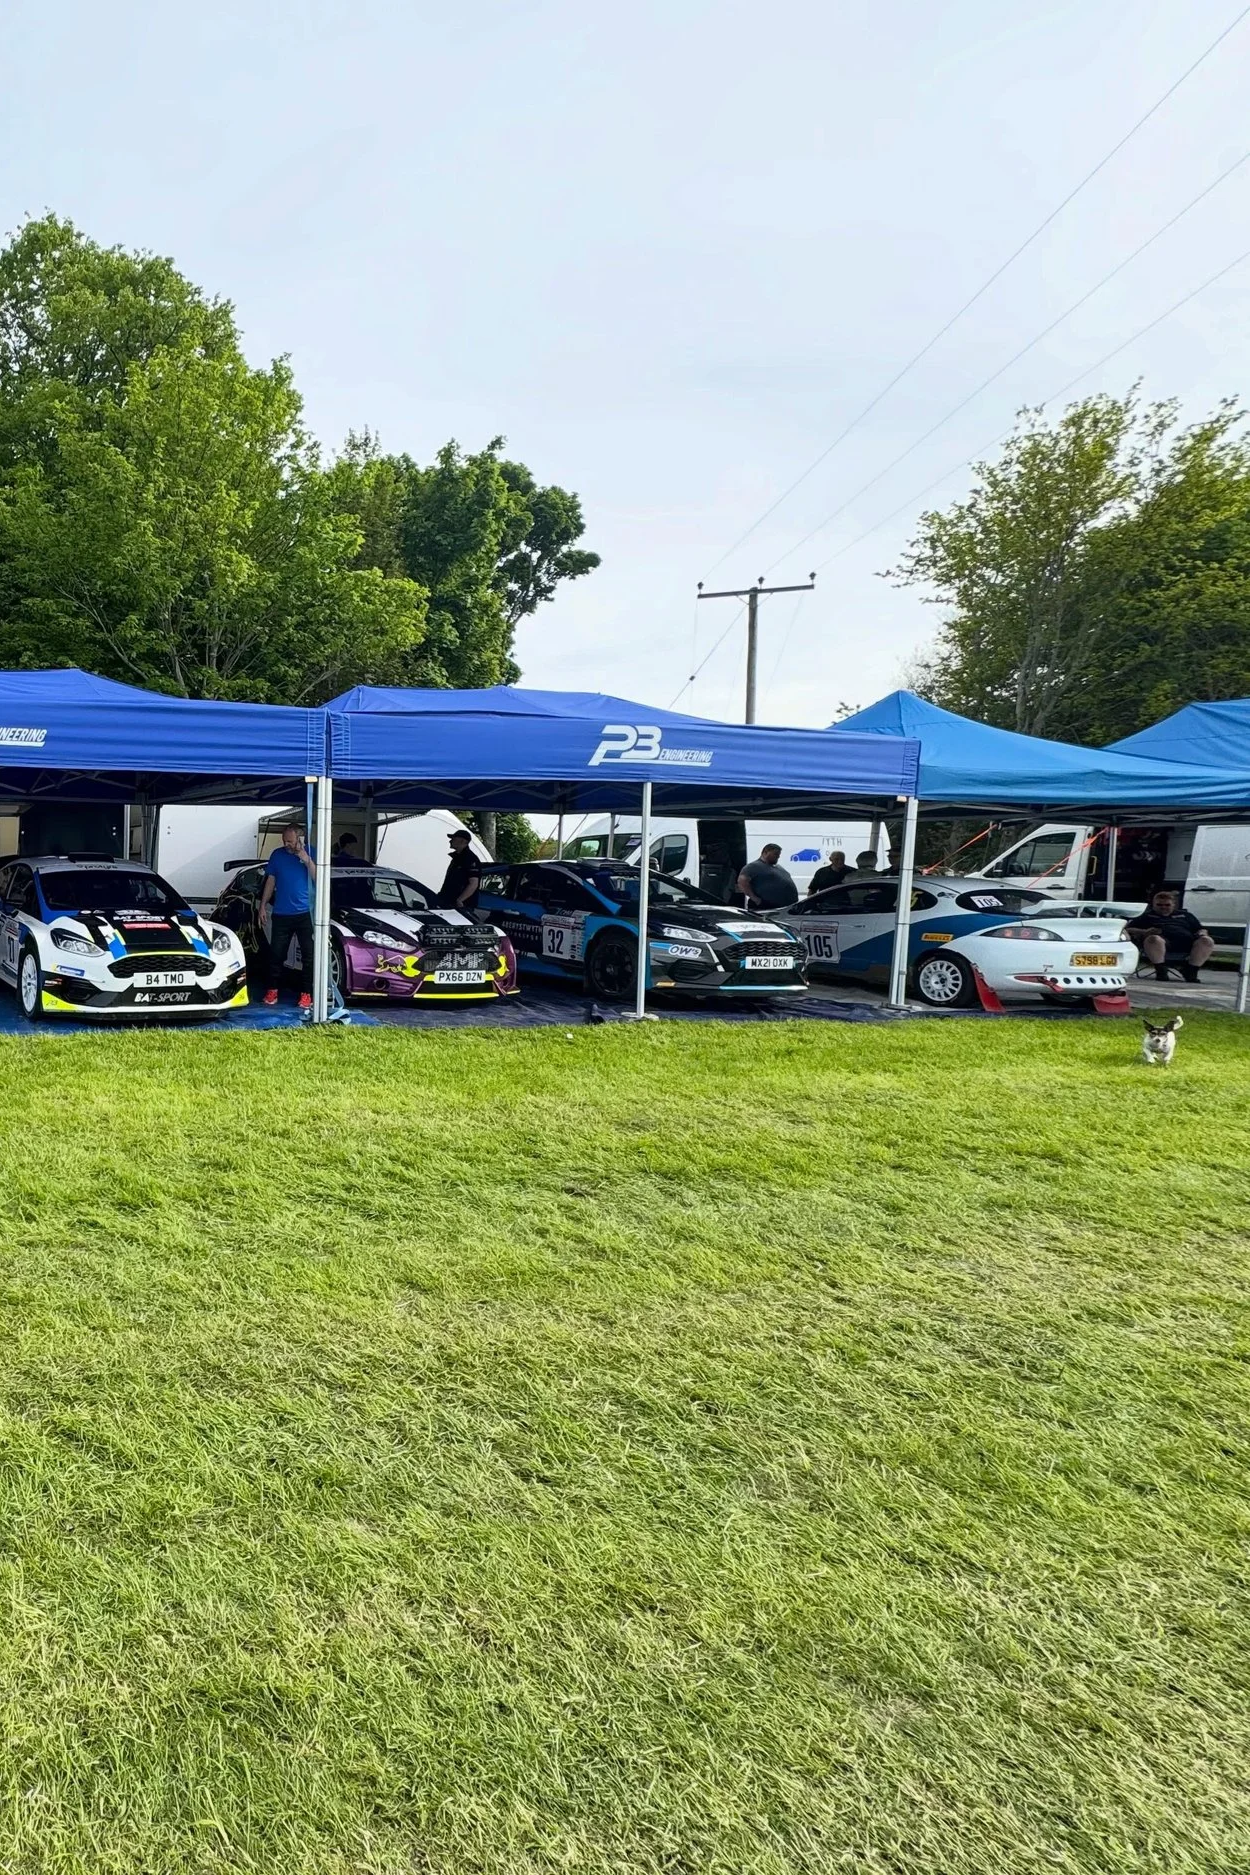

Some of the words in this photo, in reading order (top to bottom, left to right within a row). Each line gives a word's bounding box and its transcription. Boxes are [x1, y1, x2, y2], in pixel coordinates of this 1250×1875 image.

[658, 748, 714, 763] ENGINEERING
[977, 898, 1001, 909] 105
[548, 928, 564, 955] 32
[804, 934, 832, 959] 105
[772, 958, 789, 968] OXK
[146, 974, 160, 985] B4
[163, 973, 184, 984] TMO
[438, 972, 464, 982] PX66
[465, 972, 483, 982] DZN
[134, 992, 191, 1003] BAT-SPORT
